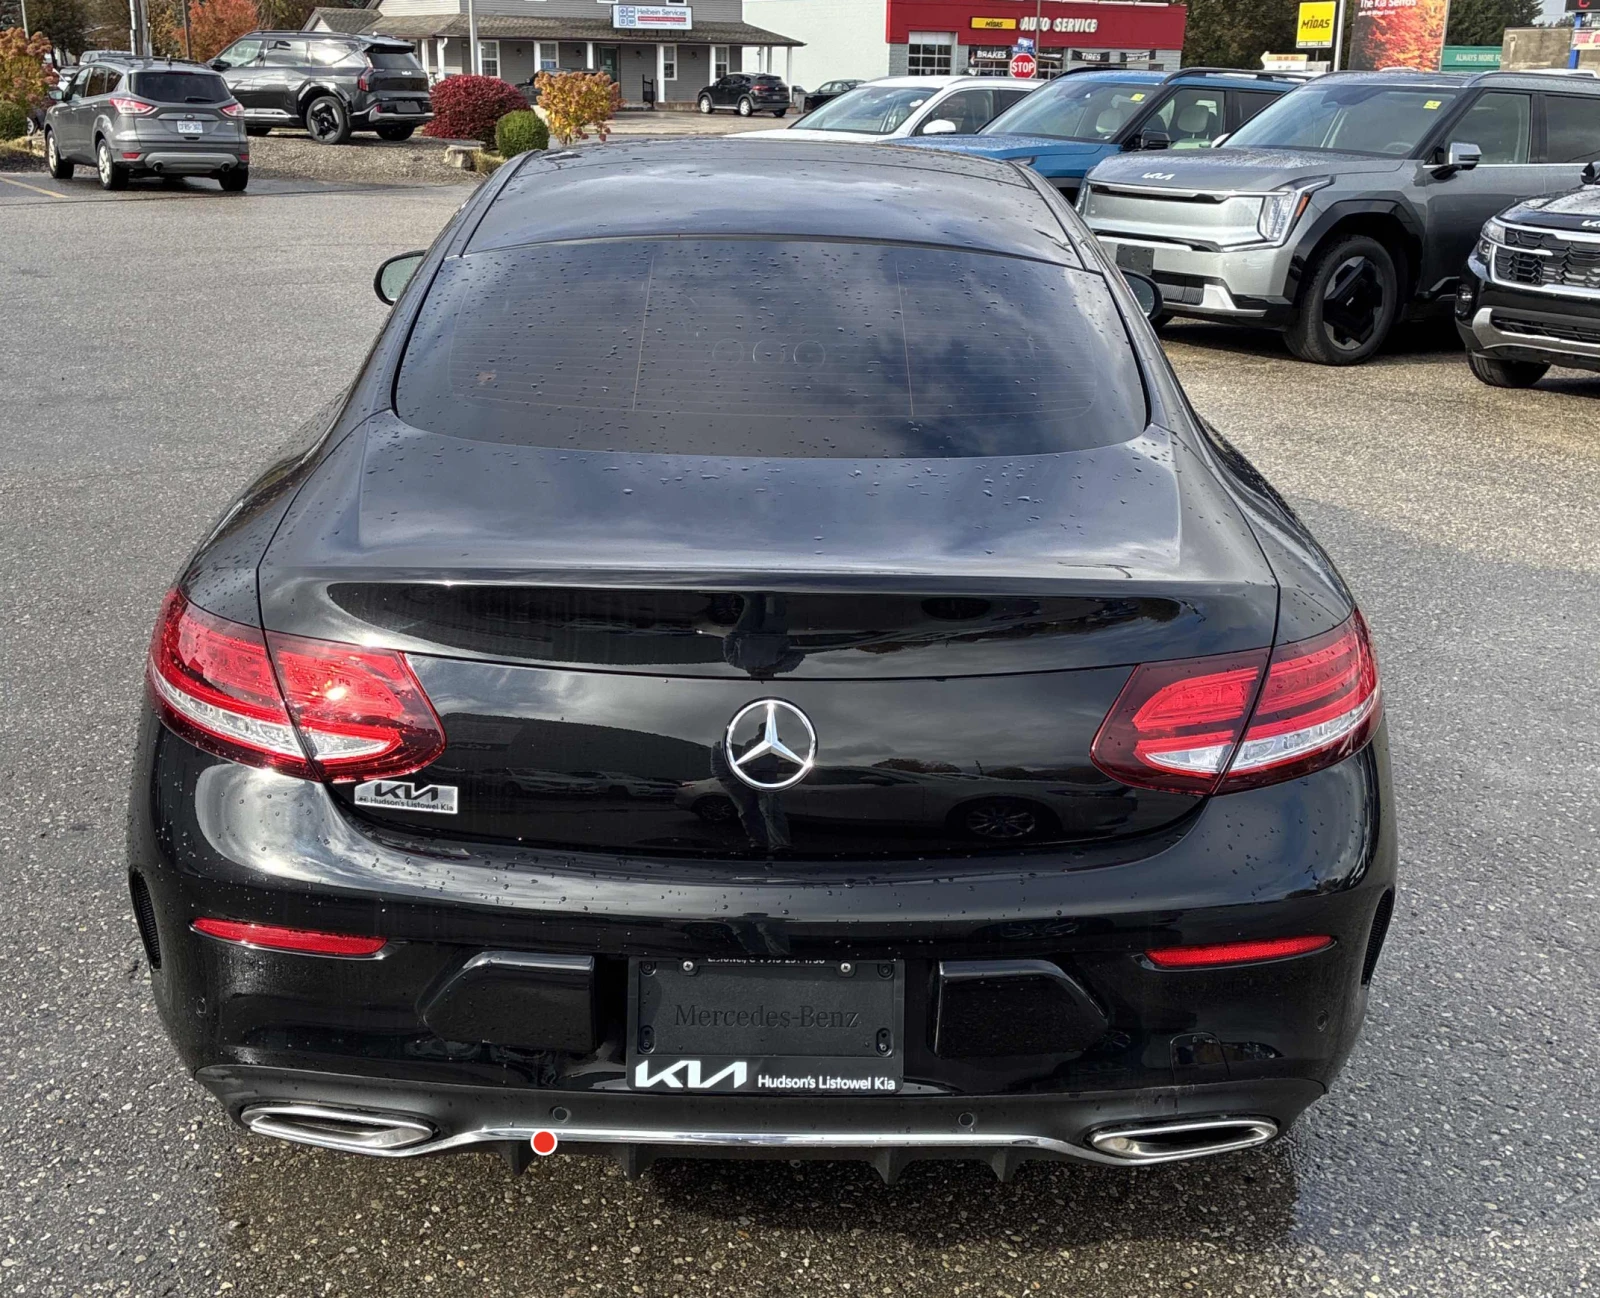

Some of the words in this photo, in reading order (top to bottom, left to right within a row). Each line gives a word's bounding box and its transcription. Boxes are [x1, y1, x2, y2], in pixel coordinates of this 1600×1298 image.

[661, 8, 687, 16] Services
[985, 19, 1003, 28] MIDAS
[1053, 17, 1098, 33] SERVICE
[1300, 15, 1332, 29] MIDAS
[976, 50, 1007, 59] BRAKES
[1081, 52, 1101, 61] TIRES
[1455, 54, 1477, 62] ALWAYS
[1478, 54, 1495, 62] MORE
[1011, 62, 1035, 73] STOP
[374, 782, 439, 802] KIA
[370, 798, 405, 807] Hudson's
[406, 800, 439, 810] Listowel
[440, 803, 454, 812] Kia
[674, 1004, 860, 1029] Mercedes-Benz
[634, 1060, 748, 1089] KIA
[757, 1074, 816, 1089] Hudson's
[818, 1075, 872, 1090] Listowel
[874, 1076, 896, 1090] Kia
